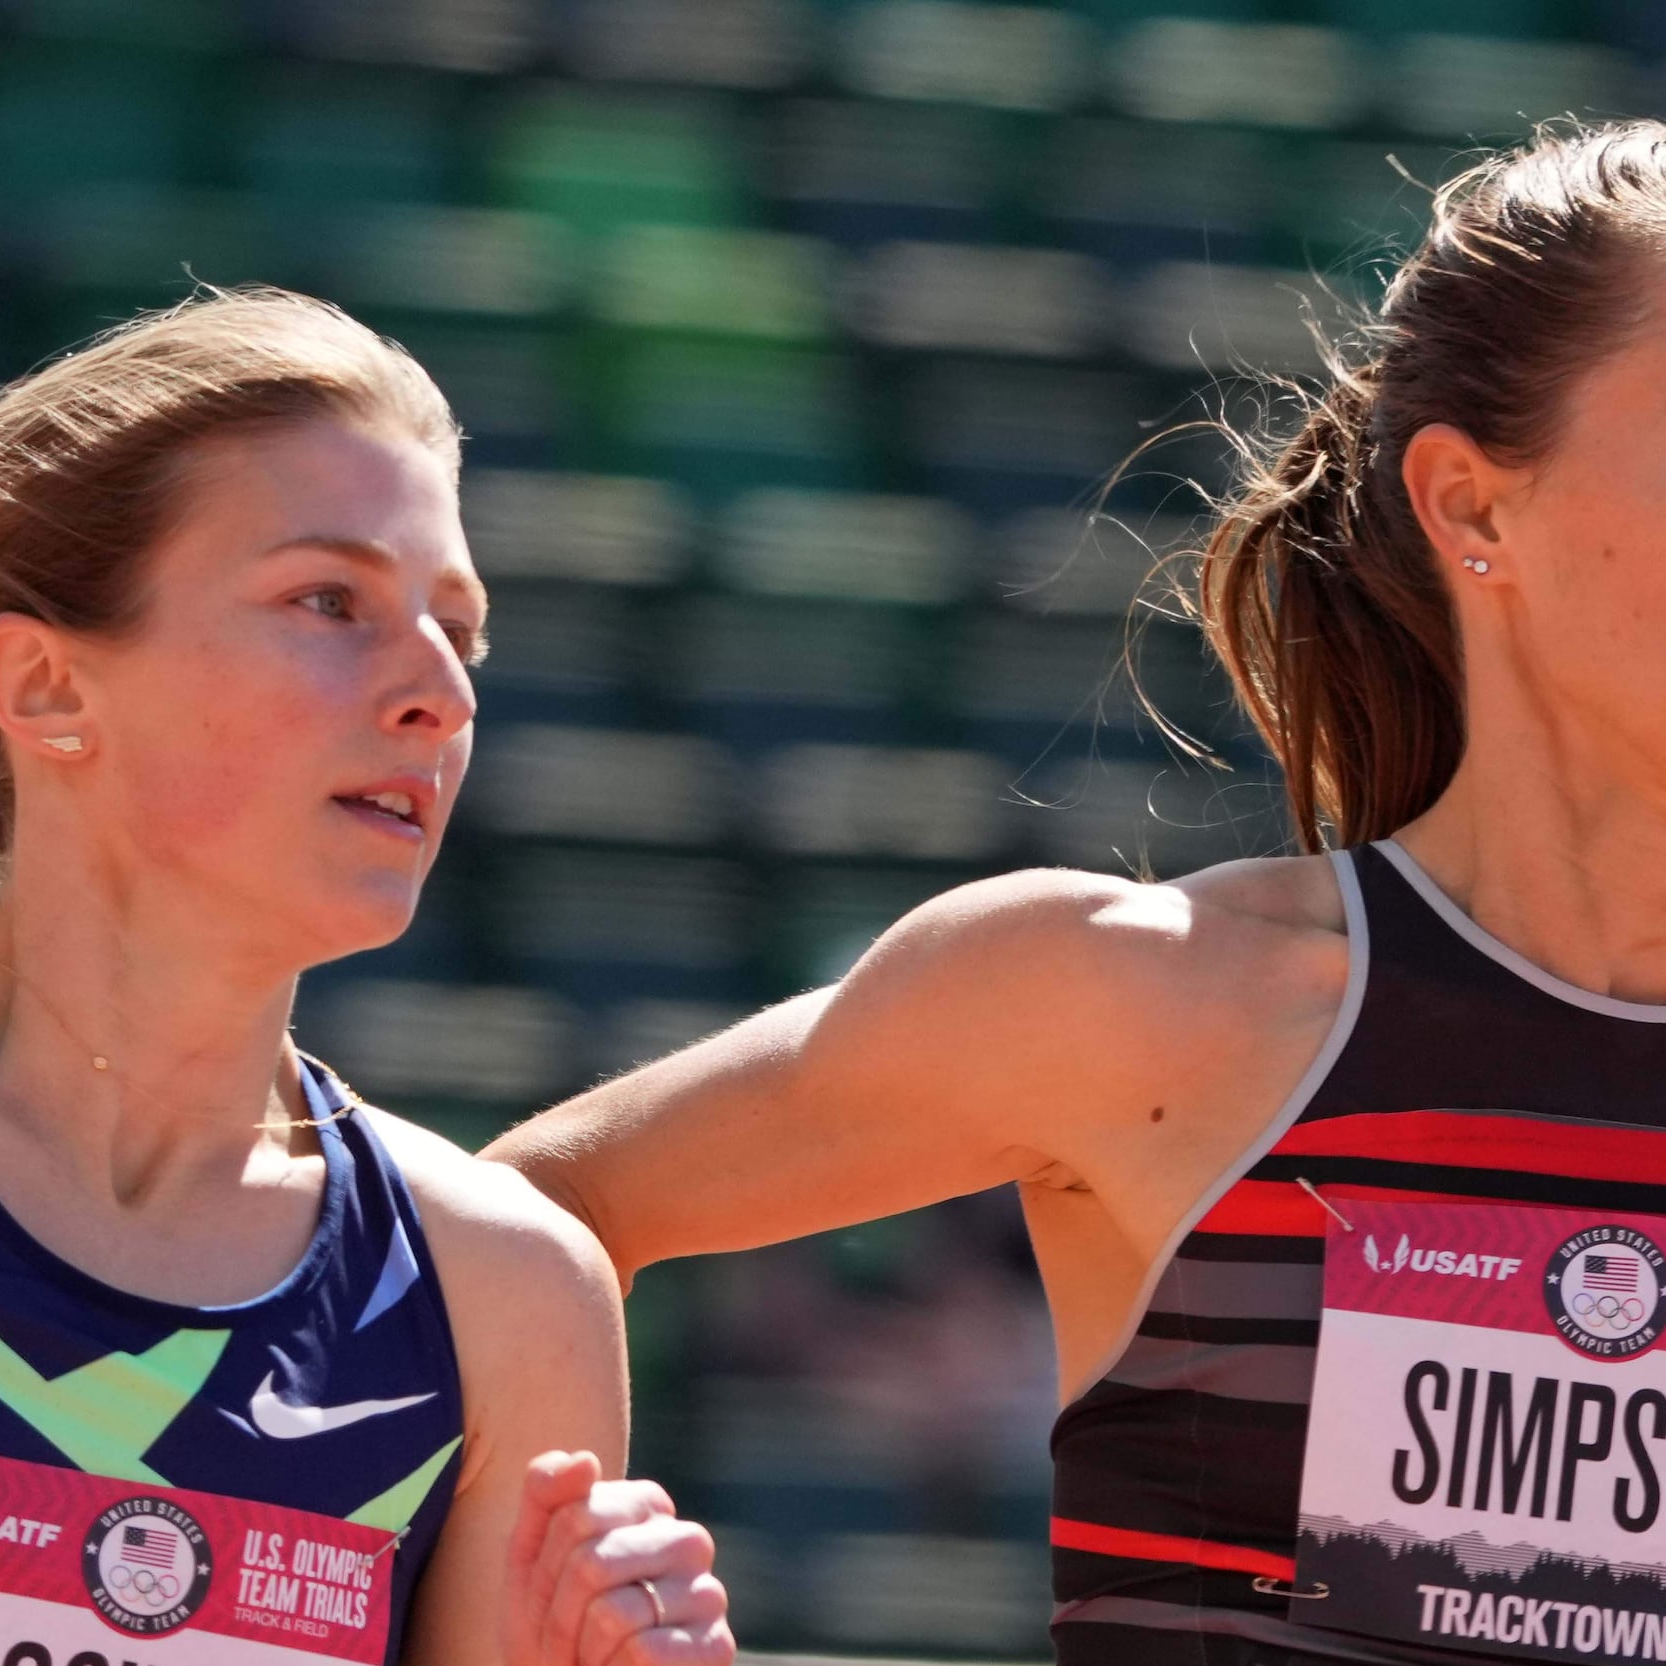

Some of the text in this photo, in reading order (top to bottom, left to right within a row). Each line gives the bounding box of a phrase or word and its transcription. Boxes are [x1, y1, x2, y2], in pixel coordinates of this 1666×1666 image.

[1409, 1248, 1523, 1281] USATF
[1559, 1228, 1611, 1259] UNITED
[1556, 1314, 1656, 1354] OLYMPIC TEAM
[99, 1499, 205, 1544] UNITED STATES
[243, 1529, 375, 1590] U.S. OLYMPIC
[92, 1587, 191, 1631] OLYMPIC TEAM
[237, 1568, 368, 1630] TEAM TRIALS
[233, 1606, 329, 1638] TRACK & FIELD
